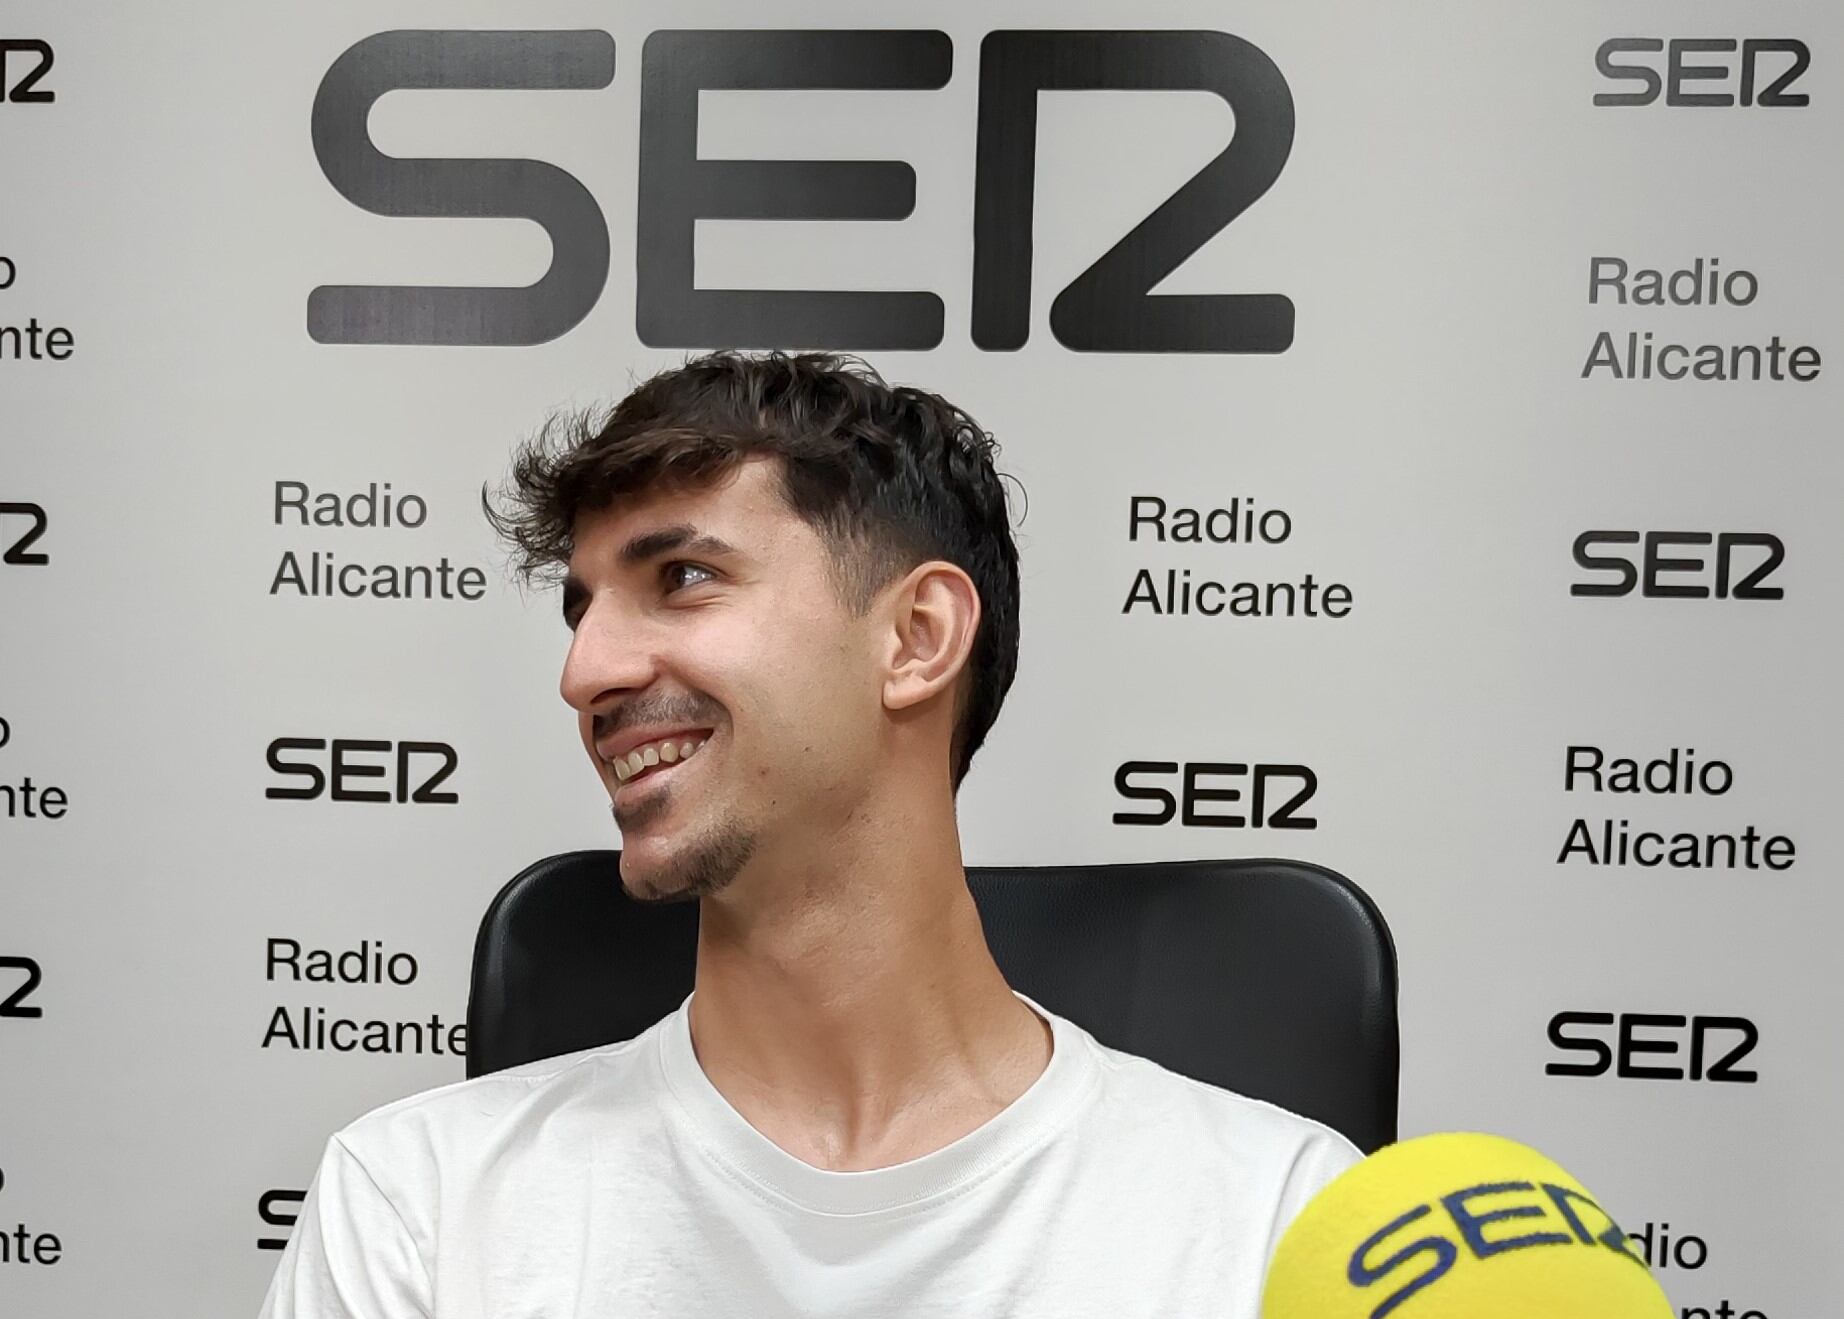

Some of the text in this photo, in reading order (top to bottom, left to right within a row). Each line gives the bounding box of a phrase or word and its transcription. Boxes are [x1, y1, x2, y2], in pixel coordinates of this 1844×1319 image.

[1593, 38, 1811, 108] SER
[307, 29, 1296, 354] SER
[1588, 257, 1759, 307] Radio
[1581, 332, 1822, 382] Alicante
[274, 481, 428, 529] Radio
[1129, 496, 1292, 545] Radio
[270, 551, 487, 600] Alicante
[1570, 530, 1786, 601] SER
[1122, 569, 1354, 619] Alicante
[265, 737, 460, 804] SER
[1564, 746, 1734, 797] Radio
[1112, 761, 1318, 831] SER
[1557, 819, 1796, 871] Alicante
[266, 938, 419, 986] Radio
[261, 1006, 467, 1056] Alicante
[1545, 1011, 1759, 1083] SER
